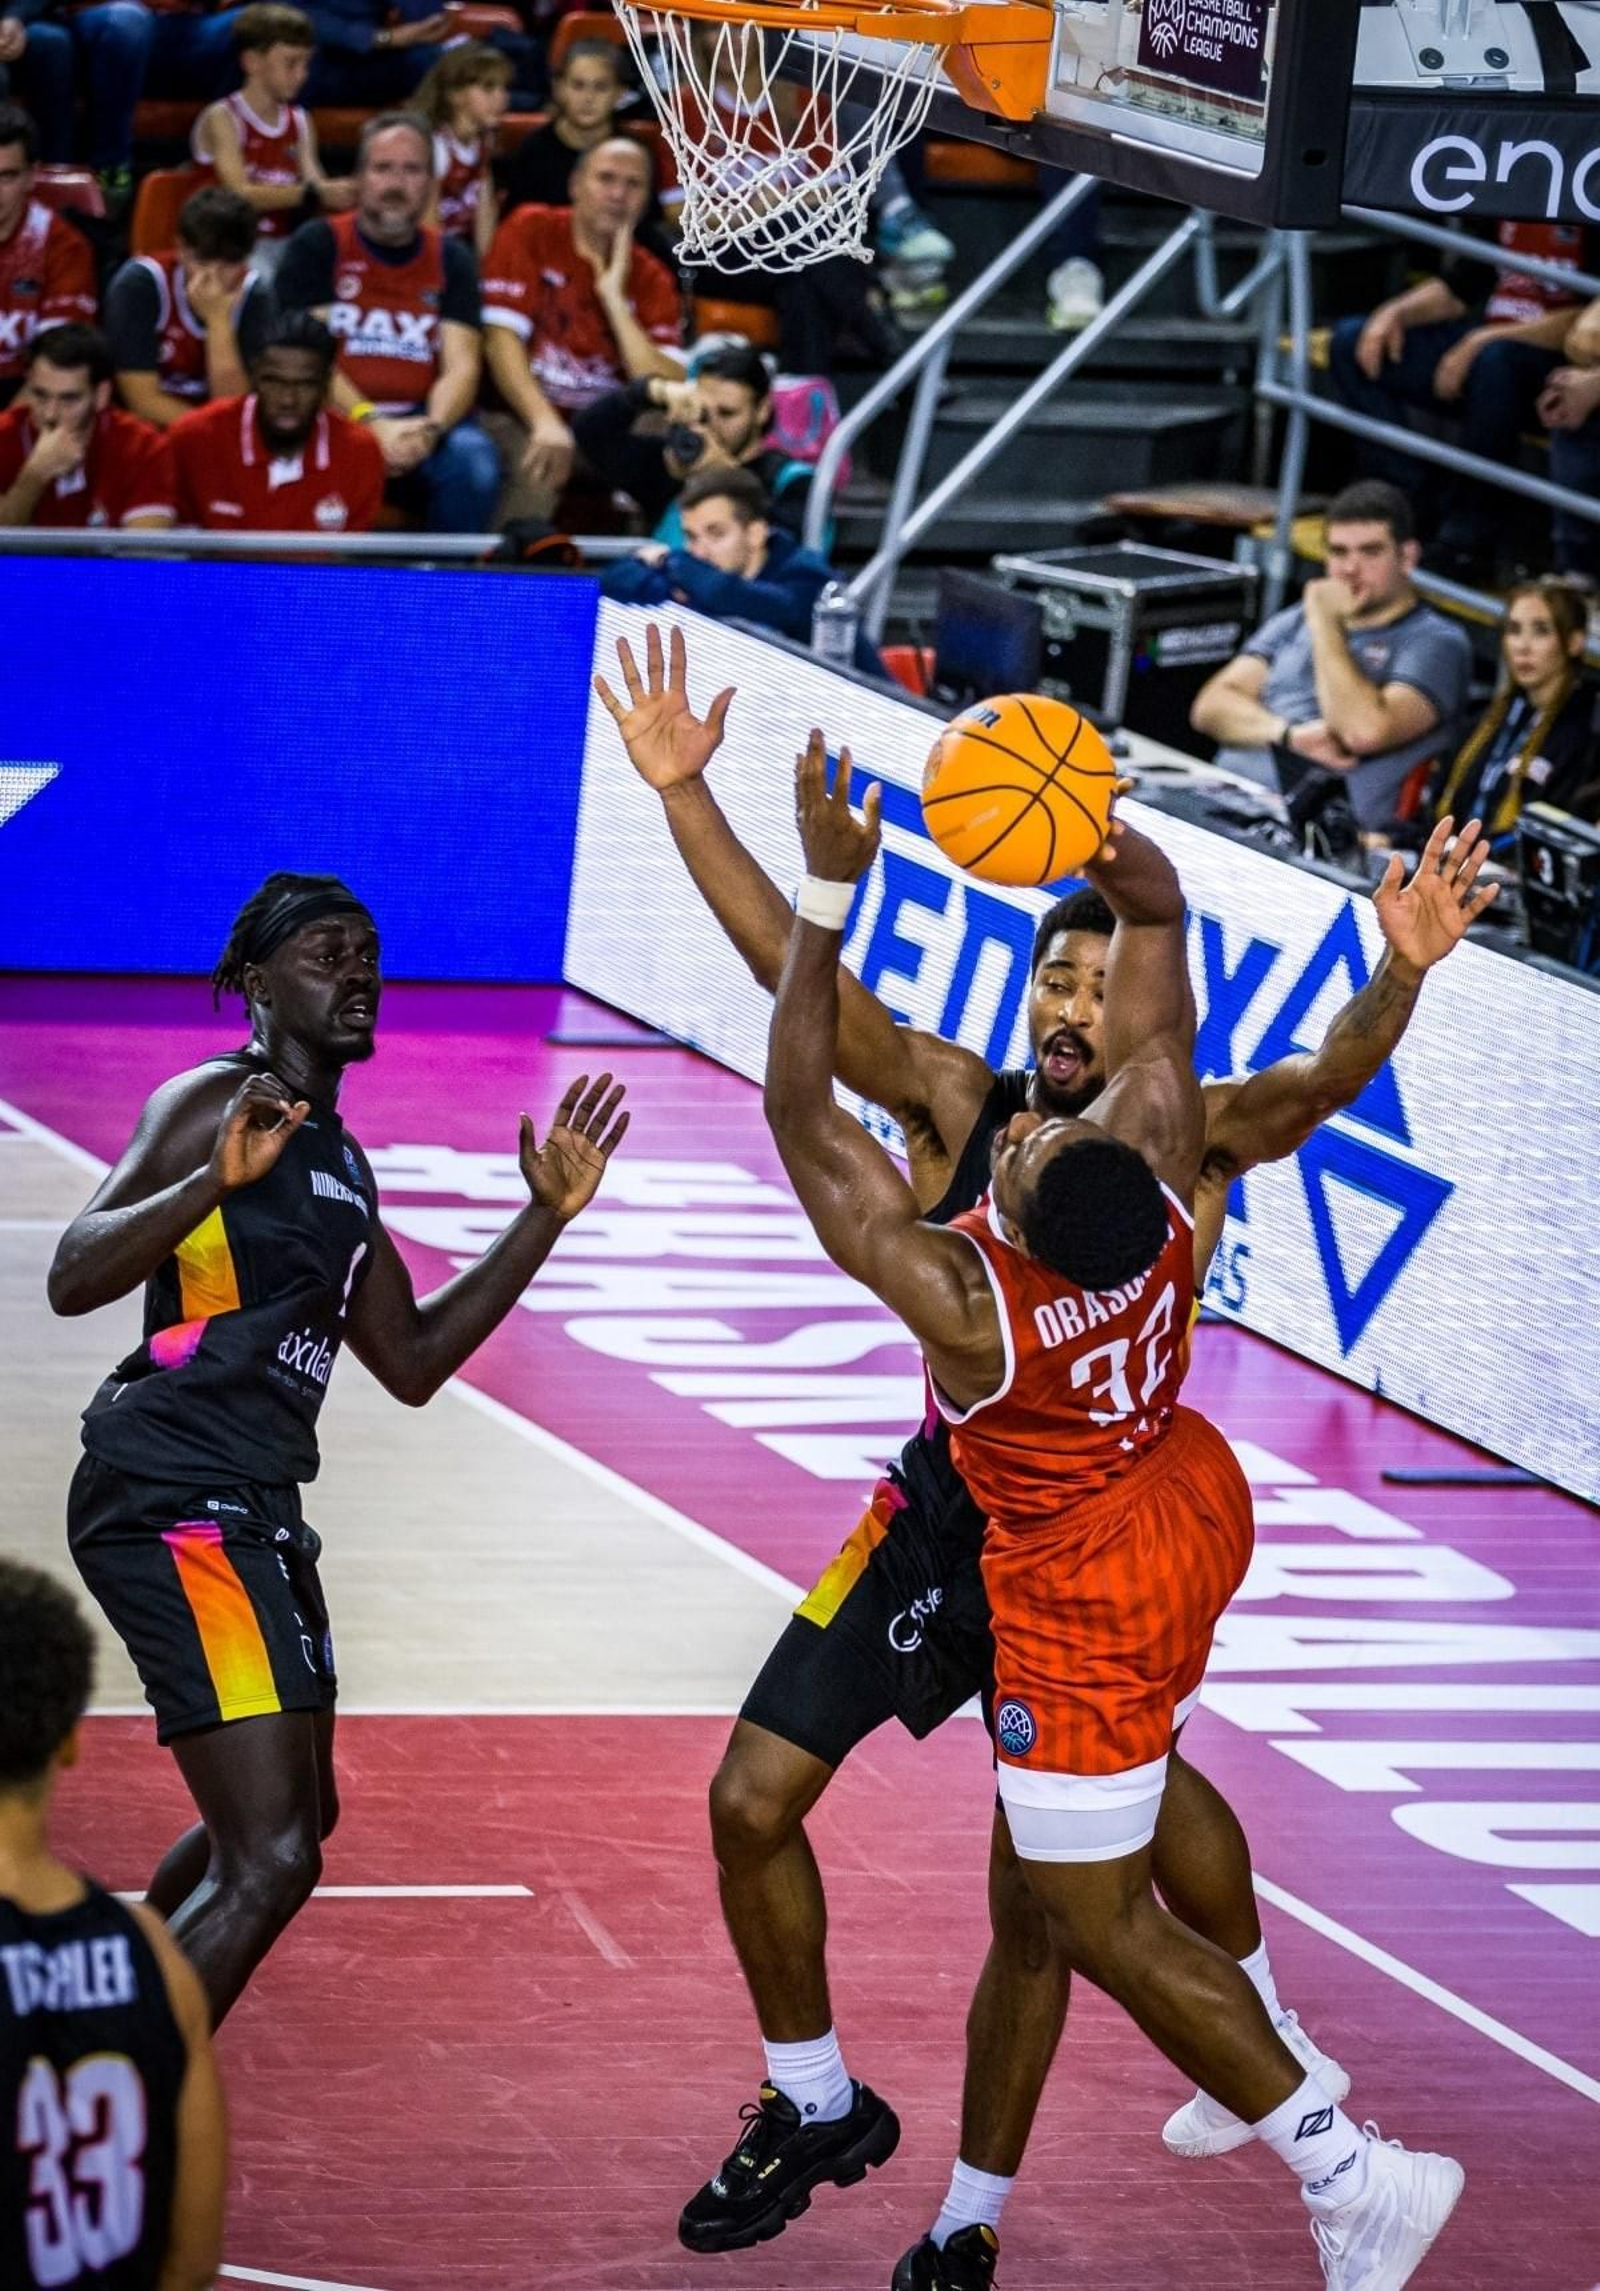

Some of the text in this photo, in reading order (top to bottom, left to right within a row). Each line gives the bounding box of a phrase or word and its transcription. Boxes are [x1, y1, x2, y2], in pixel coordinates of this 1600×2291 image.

[1183, 34, 1223, 62] LEAGUE
[1186, 10, 1259, 49] CHAMPIONS
[1070, 1280, 1175, 1428] 32
[18, 2053, 145, 2286] 33
